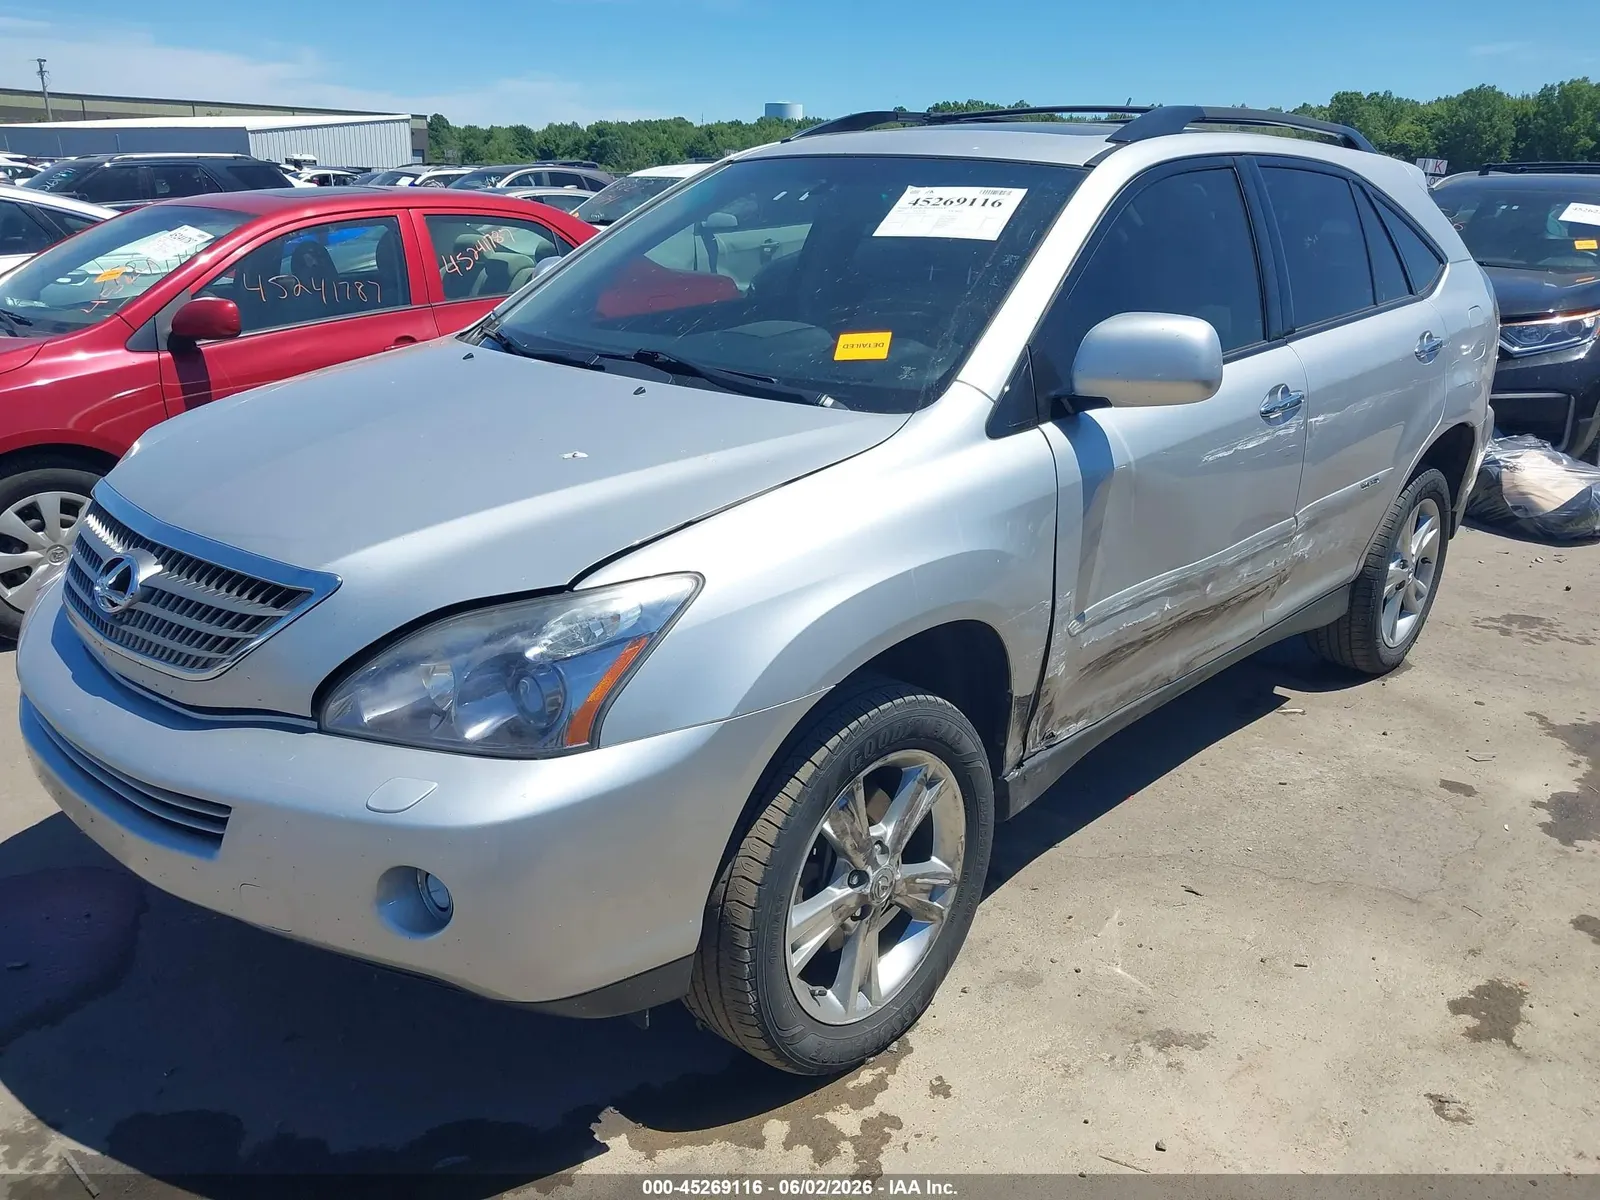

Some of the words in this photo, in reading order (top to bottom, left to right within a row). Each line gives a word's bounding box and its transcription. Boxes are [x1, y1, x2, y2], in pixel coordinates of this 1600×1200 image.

[908, 197, 1003, 208] 45269116
[441, 228, 516, 277] 45241787
[242, 273, 382, 304] 45241787
